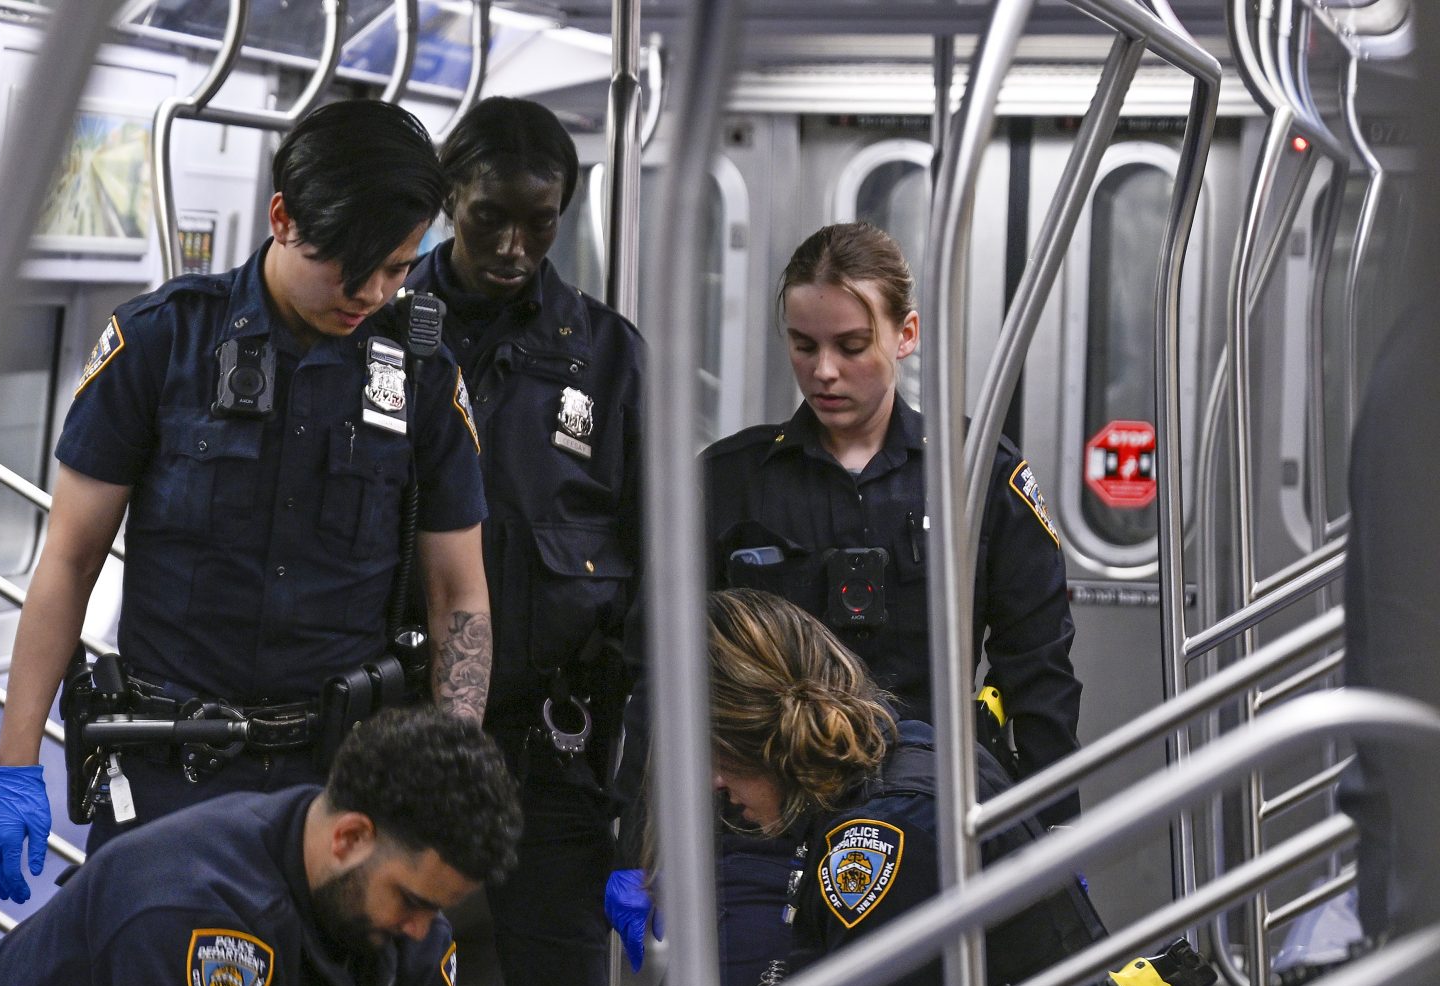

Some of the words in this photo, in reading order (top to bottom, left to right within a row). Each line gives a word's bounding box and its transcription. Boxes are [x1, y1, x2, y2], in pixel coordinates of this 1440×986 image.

[843, 826, 880, 839] POLICE
[821, 867, 833, 892] CITY
[829, 893, 842, 908] OF
[856, 891, 877, 914] NEW
[874, 861, 895, 892] YORK
